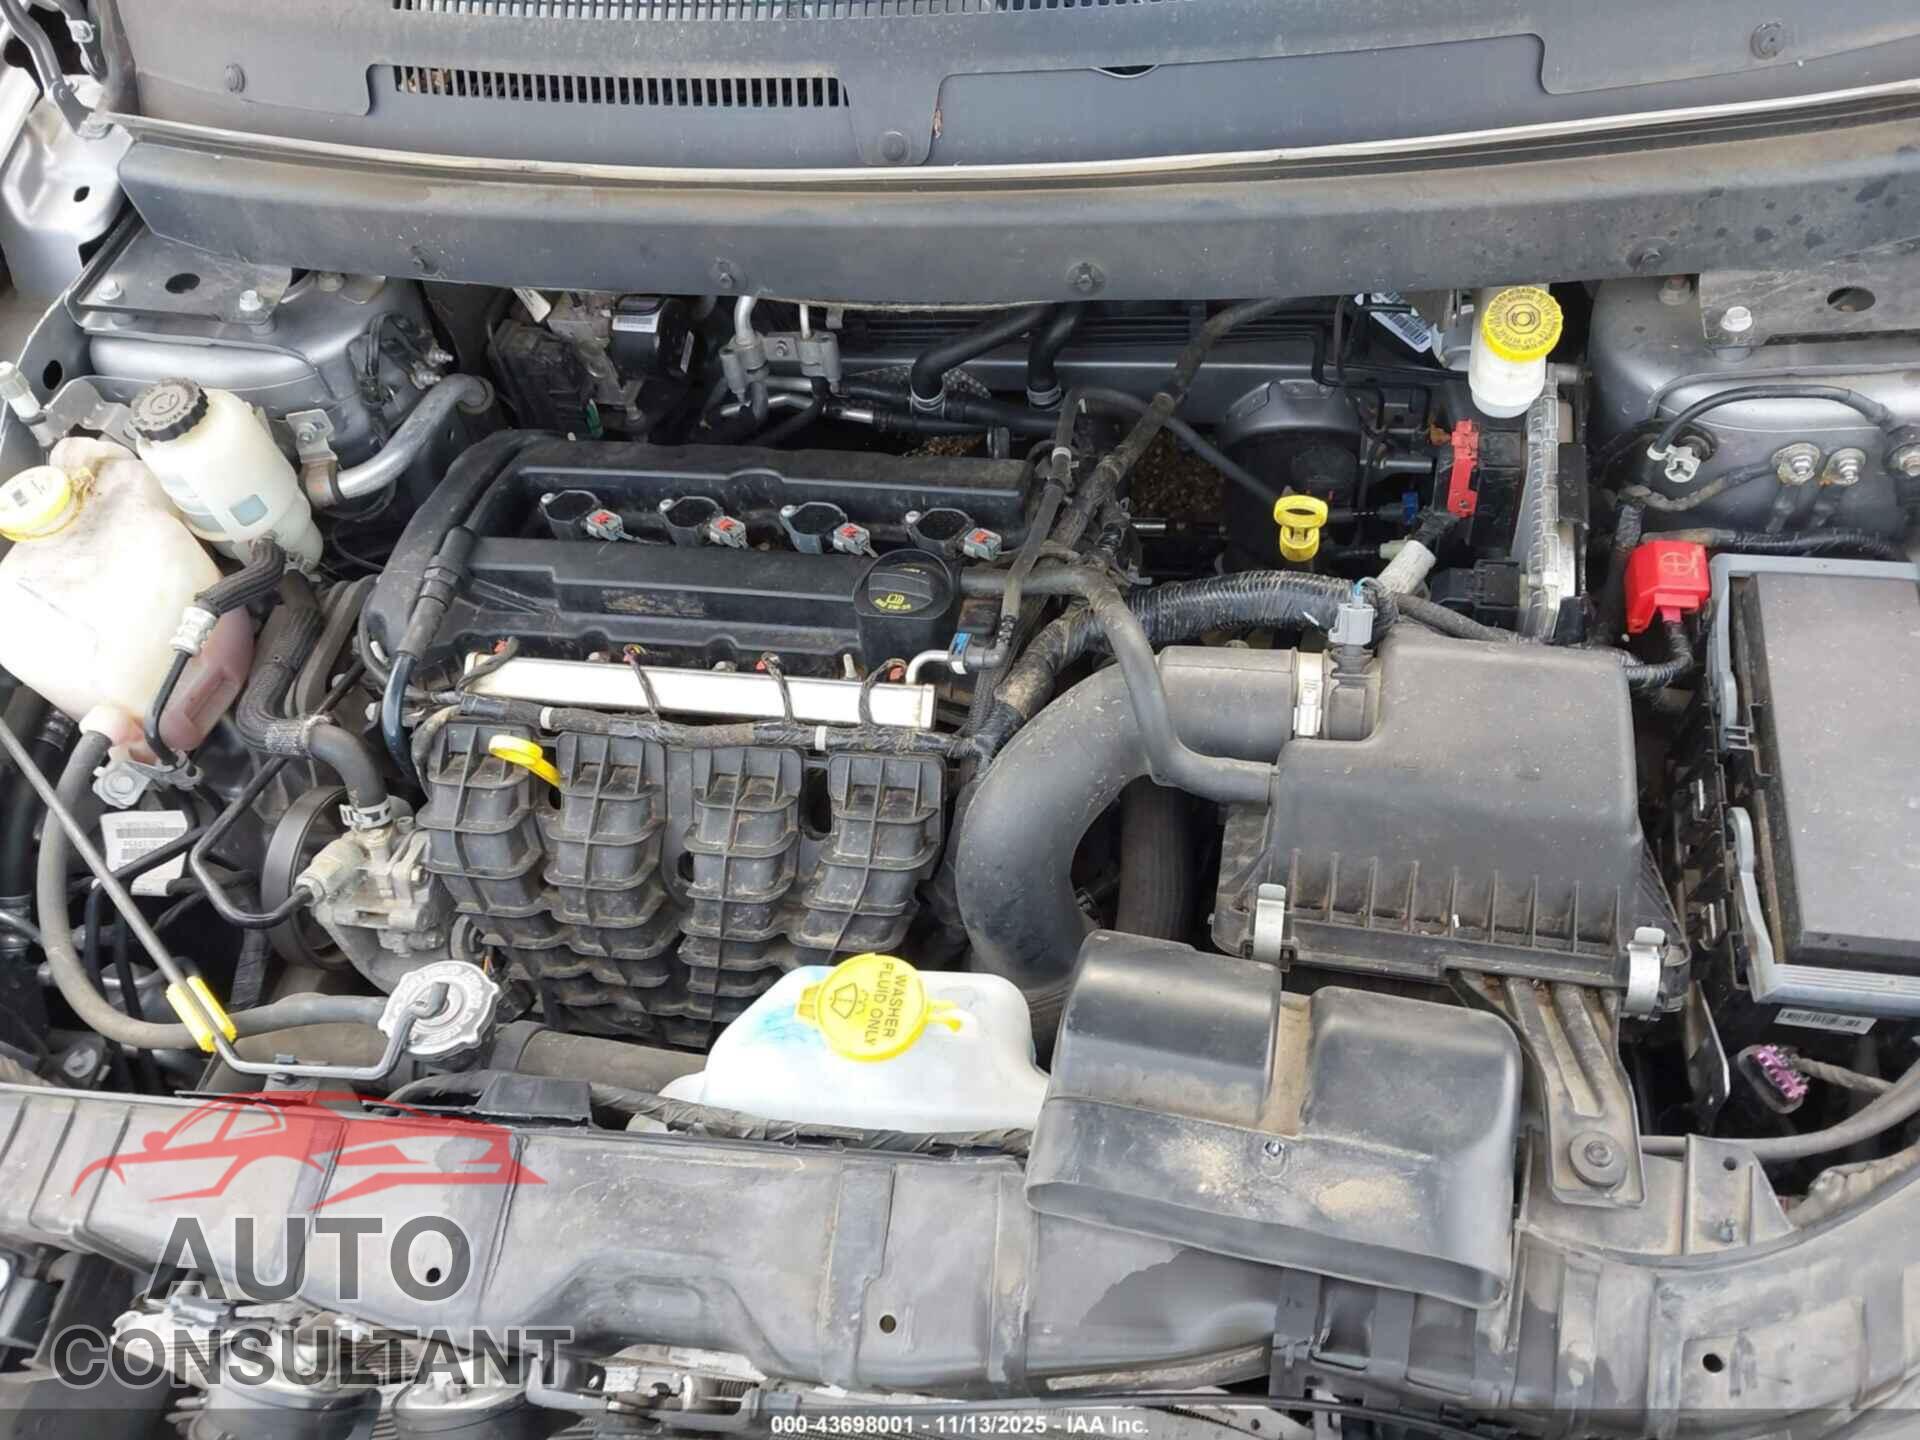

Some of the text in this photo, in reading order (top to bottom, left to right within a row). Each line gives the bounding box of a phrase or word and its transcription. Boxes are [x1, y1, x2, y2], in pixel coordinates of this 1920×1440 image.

[864, 962, 895, 1045] FLUID ONLY
[882, 974, 909, 1038] WASHER
